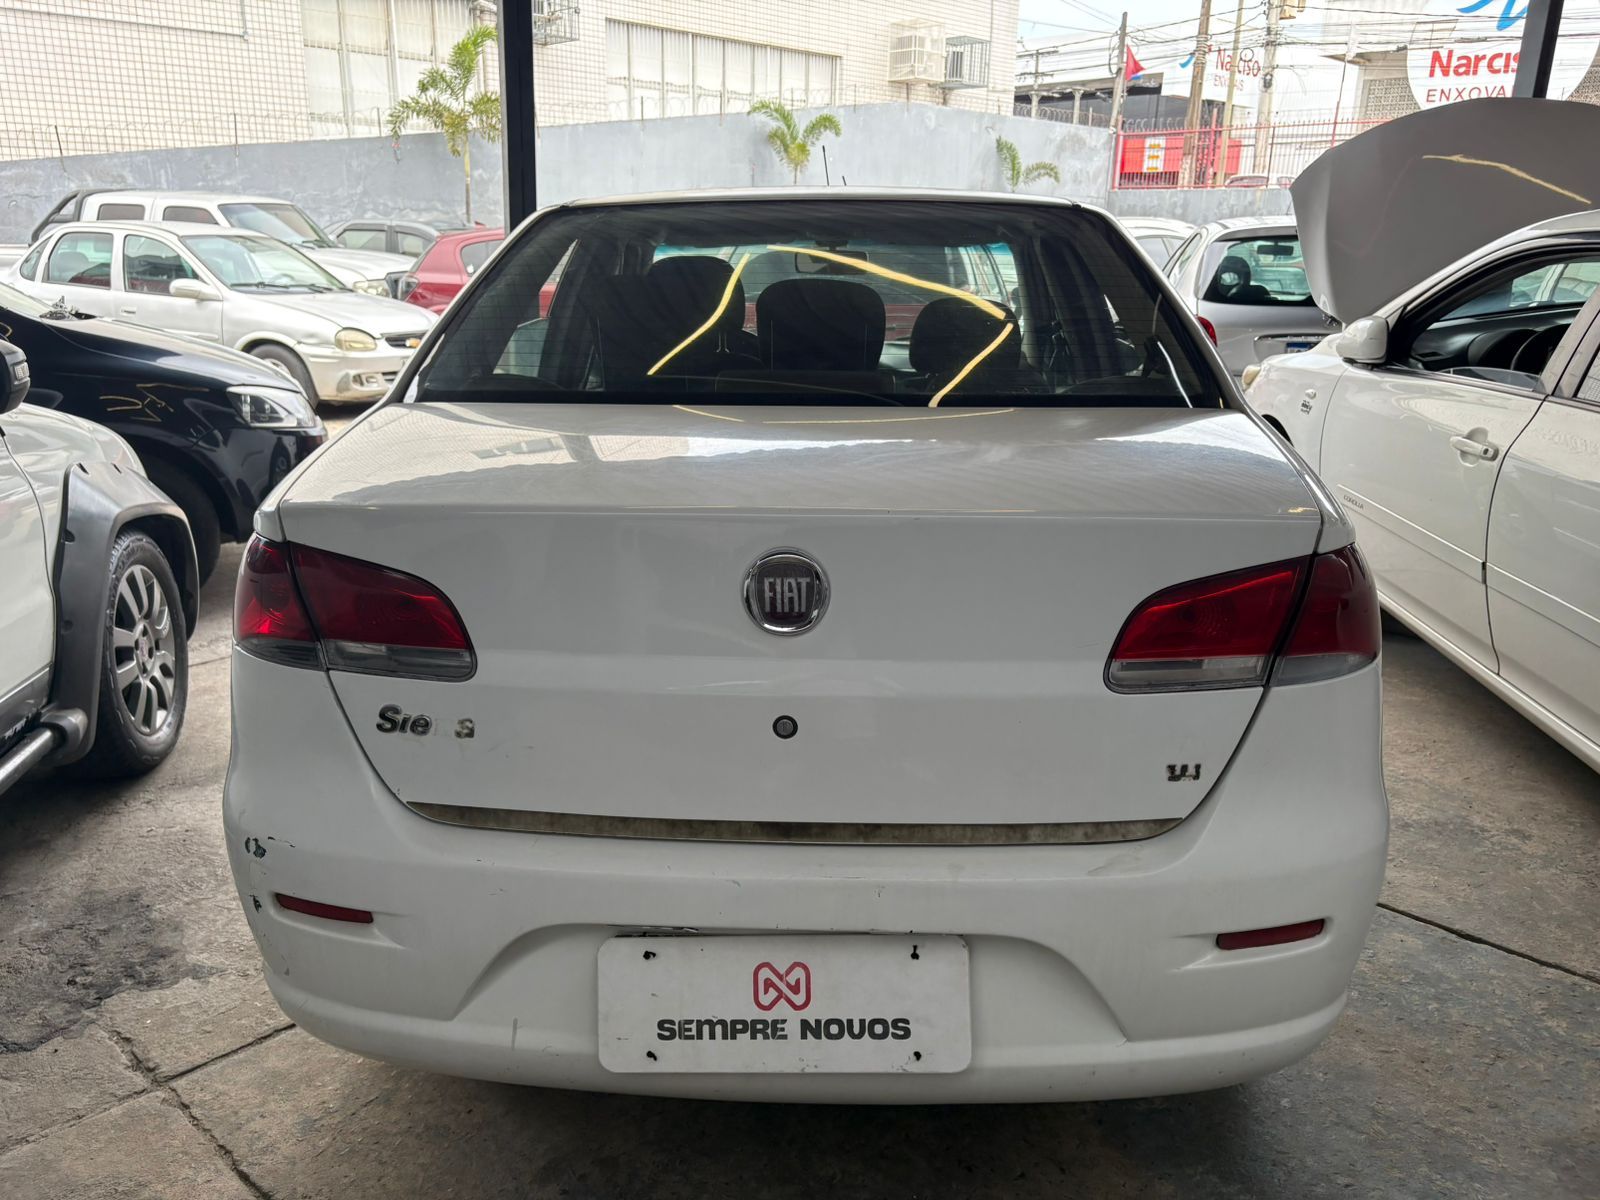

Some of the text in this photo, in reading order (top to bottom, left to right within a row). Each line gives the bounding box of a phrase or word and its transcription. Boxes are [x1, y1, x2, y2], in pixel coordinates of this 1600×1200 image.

[1216, 48, 1261, 77] Naciso
[1429, 49, 1521, 78] Narci
[1426, 85, 1515, 103] ENXOVA
[764, 577, 810, 613] FIAT
[656, 1018, 912, 1041] SEMPRE NOVOS
